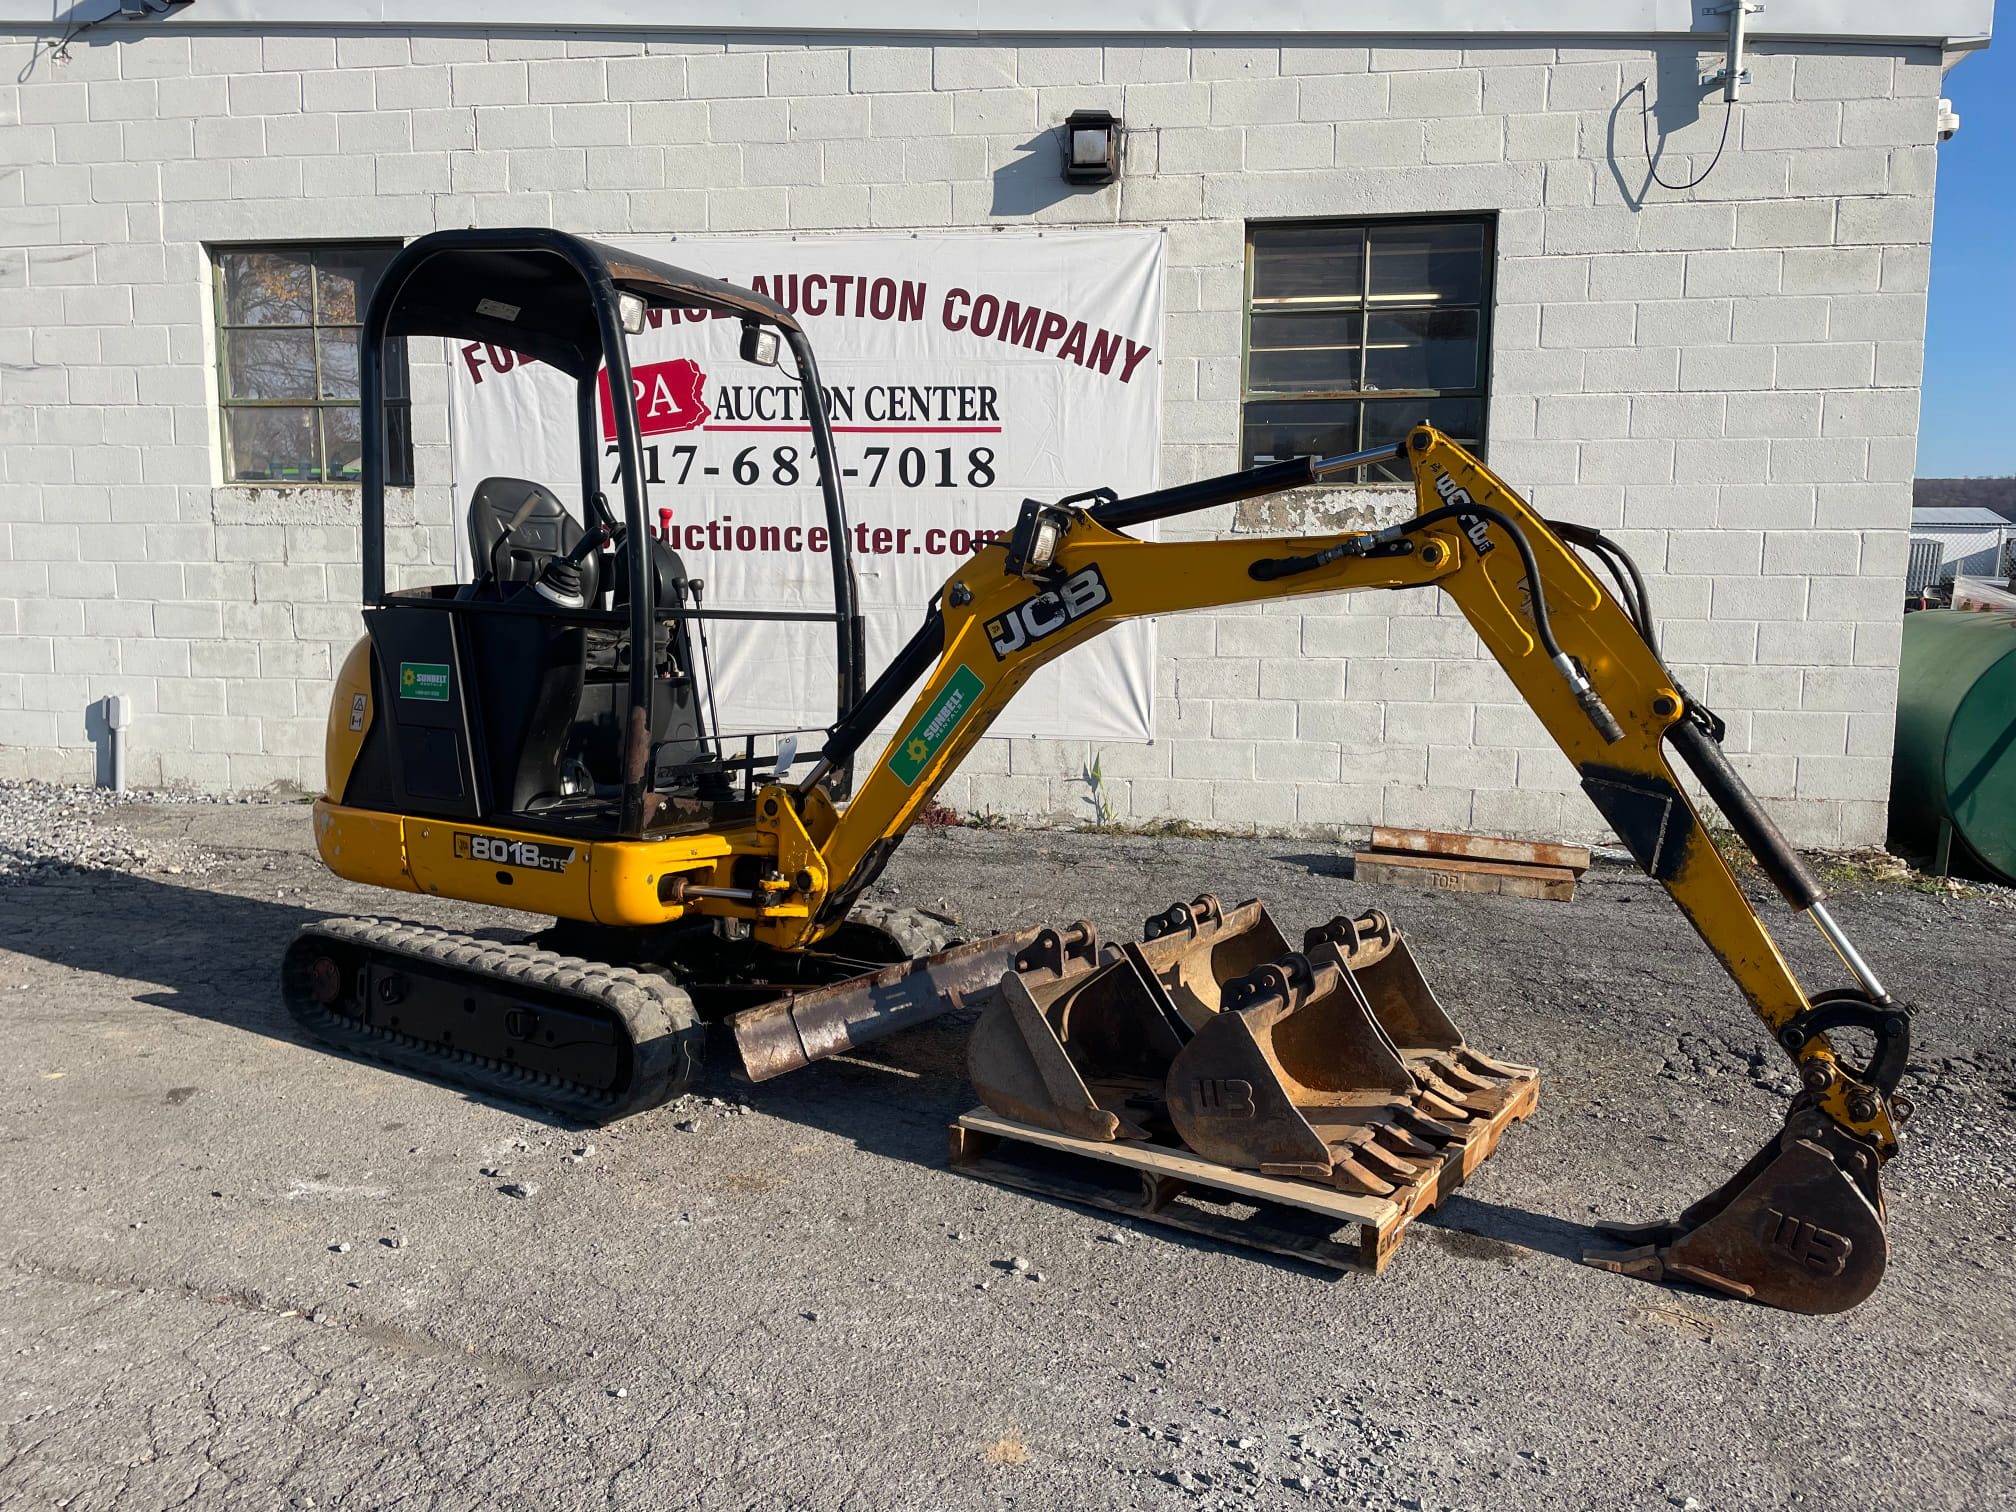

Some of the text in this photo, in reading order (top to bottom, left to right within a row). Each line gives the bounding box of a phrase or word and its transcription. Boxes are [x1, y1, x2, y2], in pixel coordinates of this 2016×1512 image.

[942, 287, 1152, 383] COMPANY
[714, 386, 855, 421] AUCTN
[864, 386, 1000, 421] CENTER
[605, 445, 996, 488] 717-68-7018
[994, 569, 1106, 654] JCB
[923, 688, 963, 741] SUNBELT
[935, 703, 962, 738] RENTALS
[1430, 872, 1459, 889] TOP
